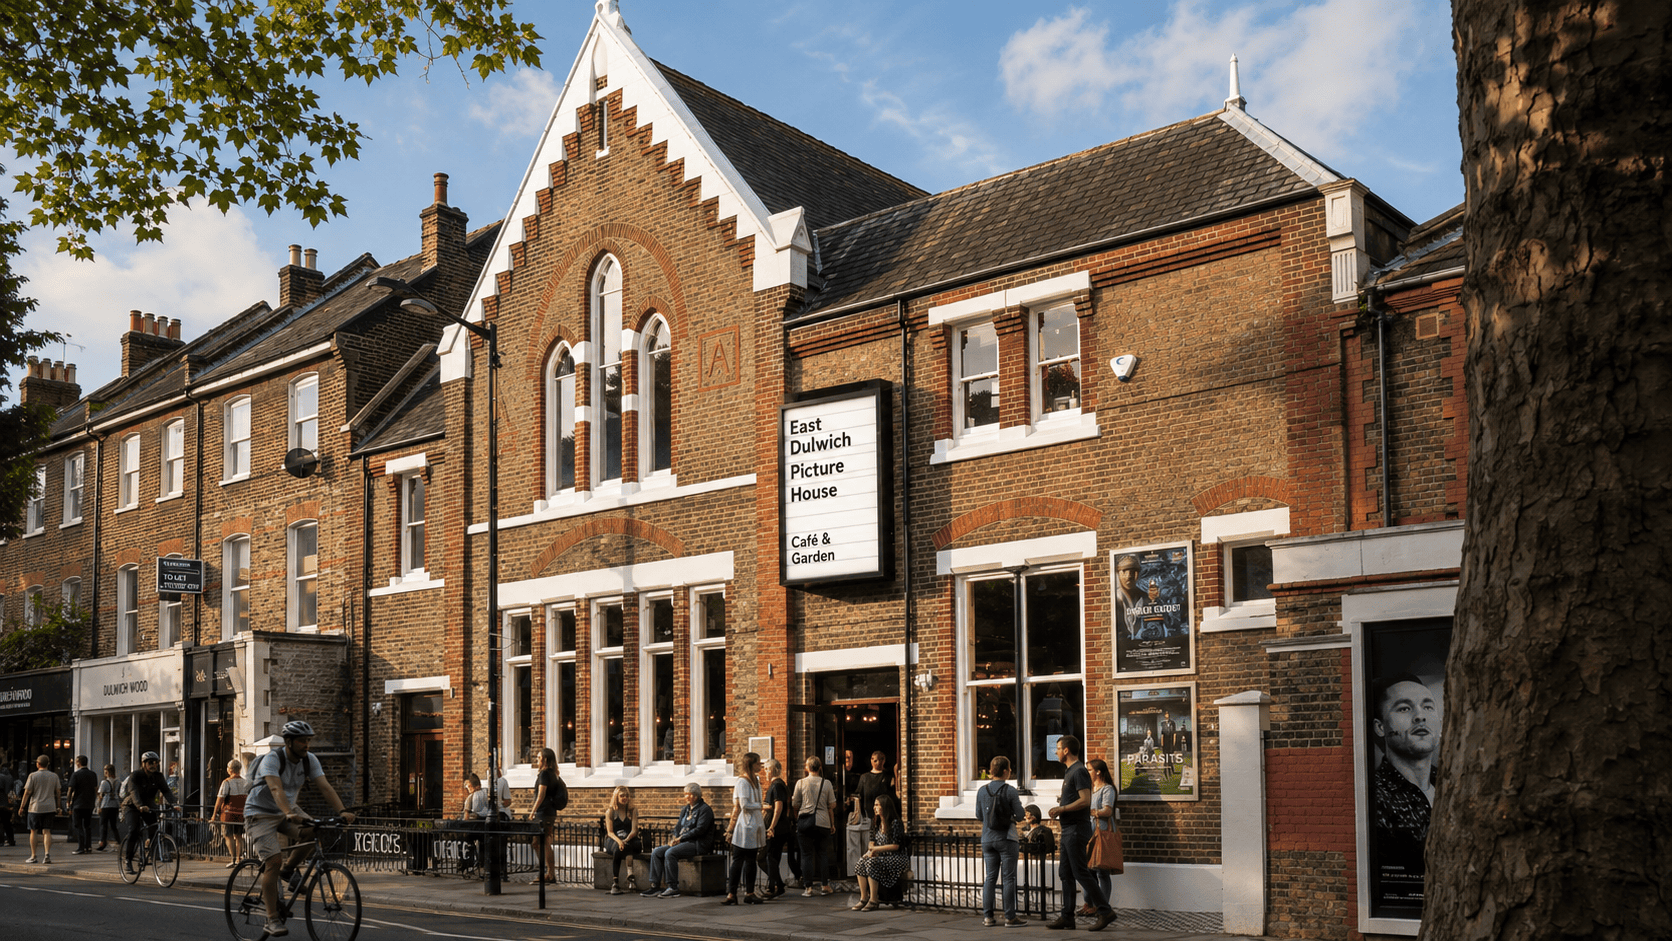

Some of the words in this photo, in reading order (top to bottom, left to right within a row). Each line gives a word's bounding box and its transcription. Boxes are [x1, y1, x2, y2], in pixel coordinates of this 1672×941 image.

[708, 339, 729, 378] A
[790, 417, 822, 435] East
[790, 432, 851, 455] Dulwich
[790, 461, 845, 480] Picture
[791, 486, 838, 503] House
[791, 533, 818, 548] Café
[822, 532, 831, 545] &
[791, 550, 835, 565] Garden
[163, 573, 174, 581] TO
[129, 680, 149, 693] WOOD
[1127, 753, 1184, 766] PARASITS
